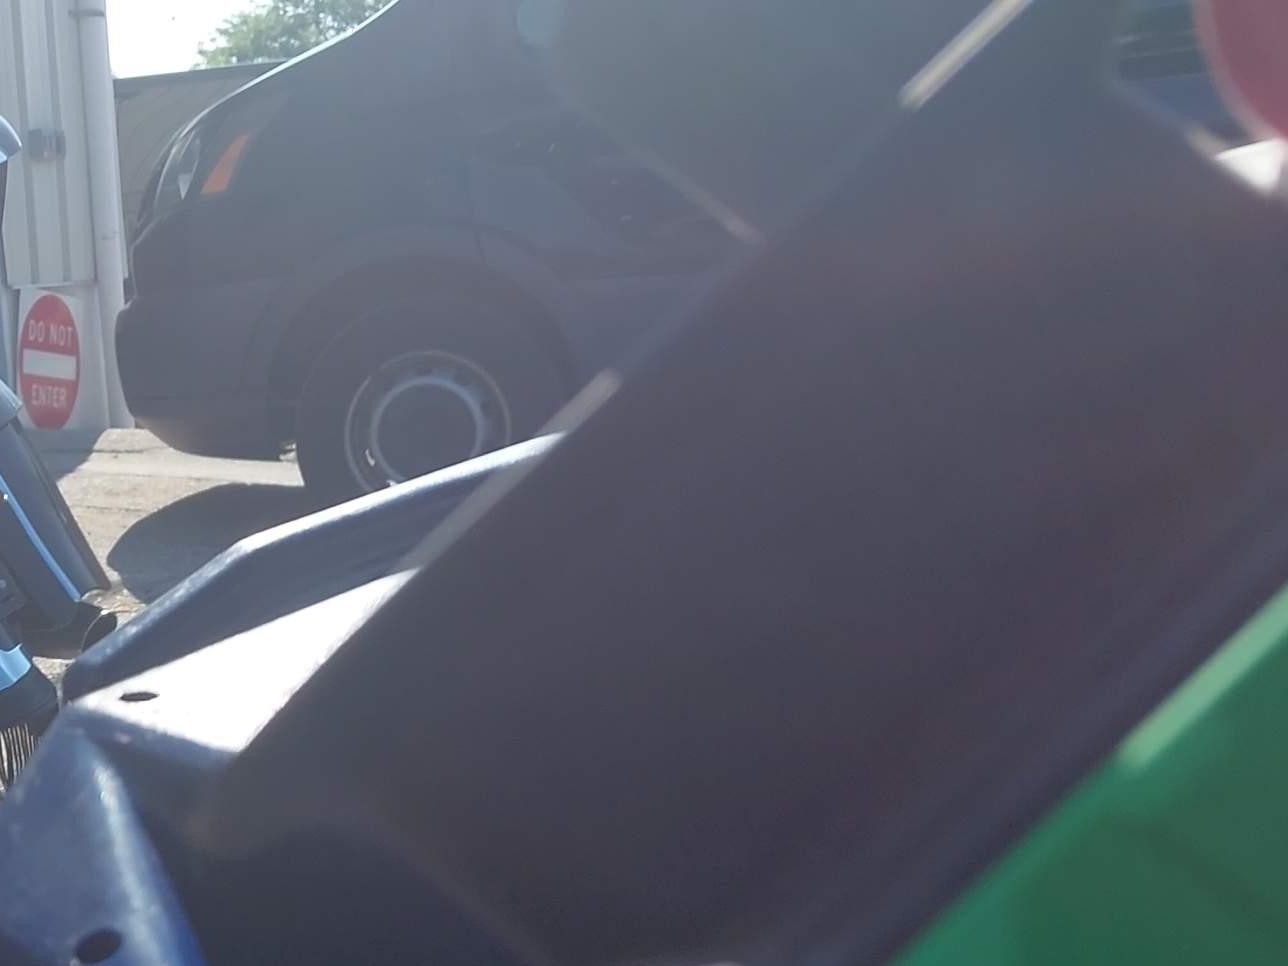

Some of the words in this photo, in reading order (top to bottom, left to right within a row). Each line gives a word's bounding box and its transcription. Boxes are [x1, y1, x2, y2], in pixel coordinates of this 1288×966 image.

[28, 319, 46, 342] DO
[49, 323, 73, 347] NOT
[31, 384, 67, 408] ENTER
